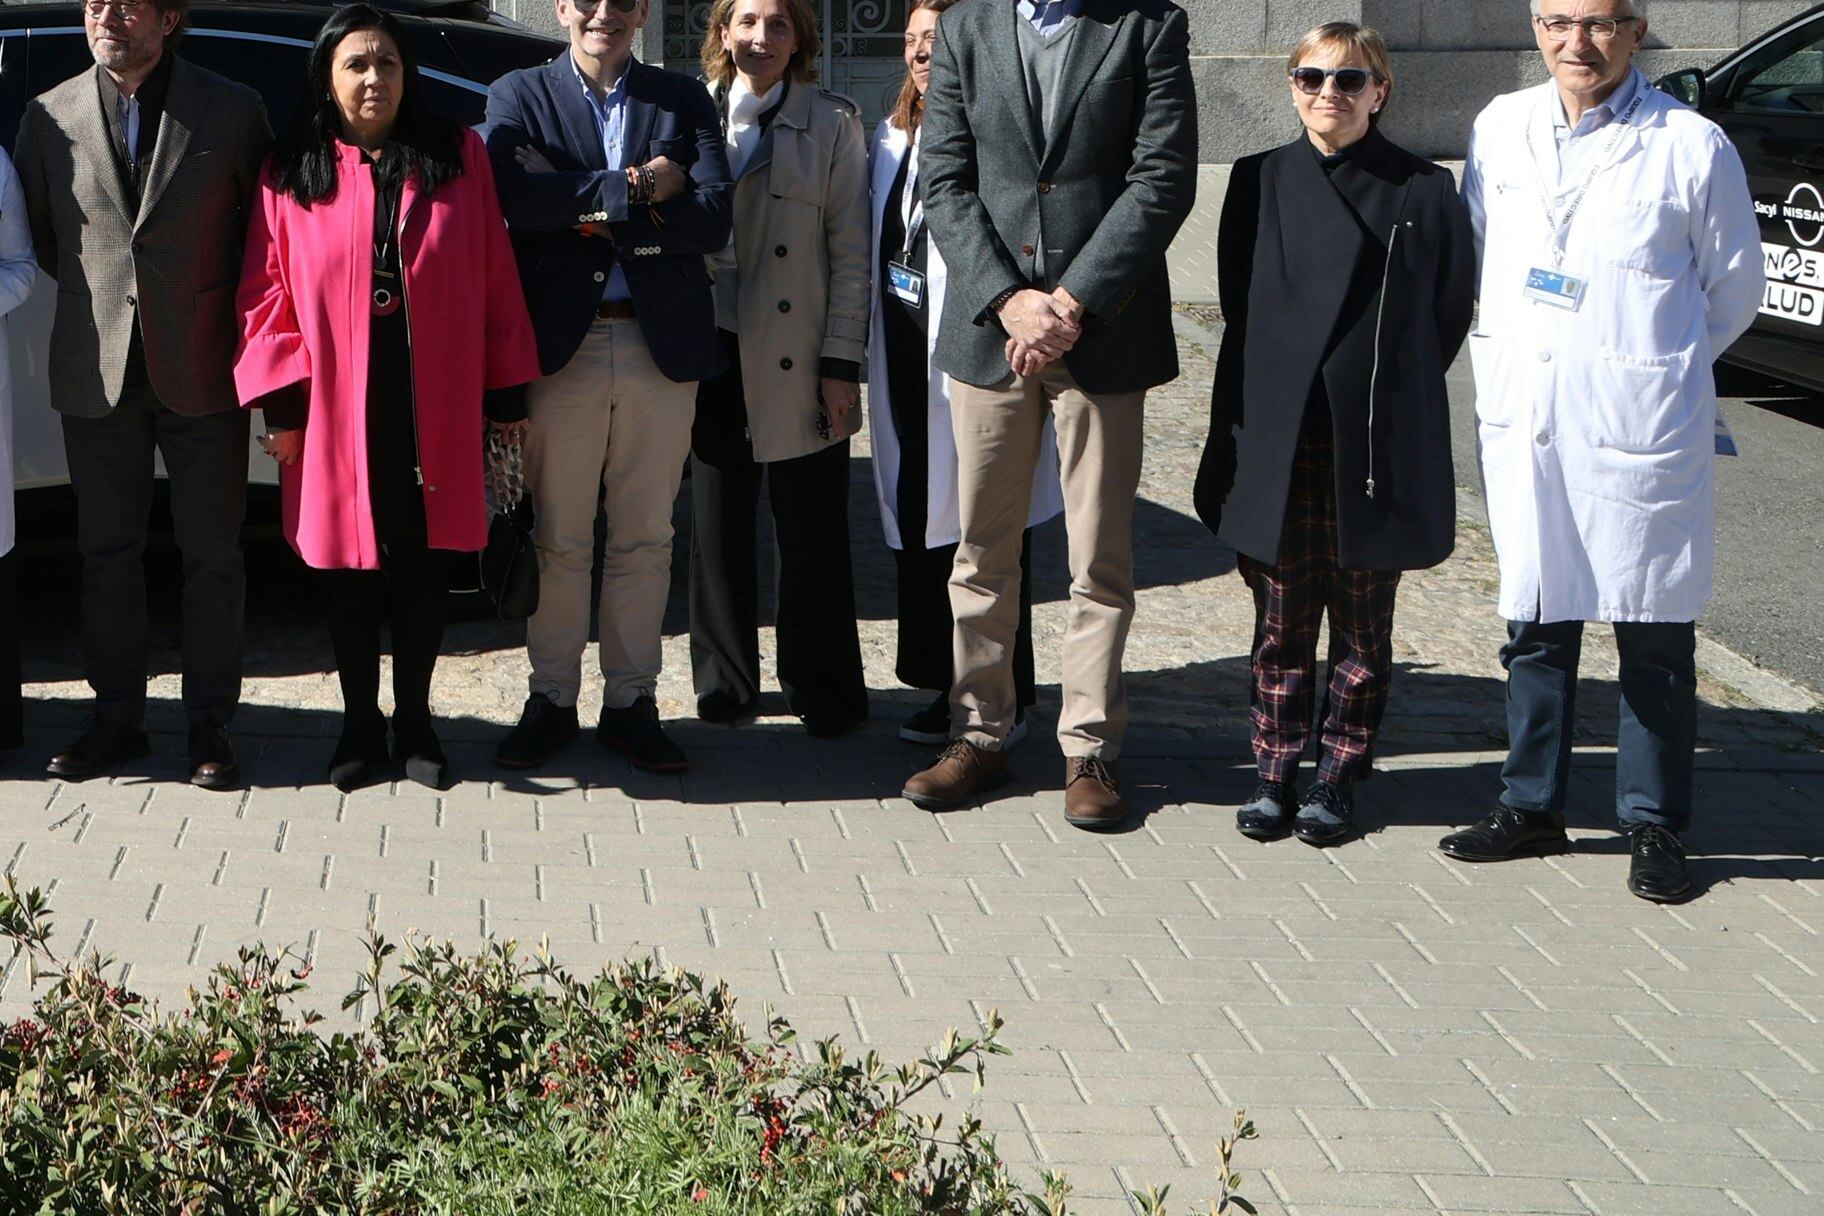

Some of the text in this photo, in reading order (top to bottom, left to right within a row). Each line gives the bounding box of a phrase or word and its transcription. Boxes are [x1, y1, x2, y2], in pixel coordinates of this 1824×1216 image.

[1624, 96, 1643, 120] EQUIPO
[1562, 188, 1586, 225] DIRECTIVO
[1754, 201, 1776, 218] Sacyl
[1762, 286, 1815, 317] LUD
